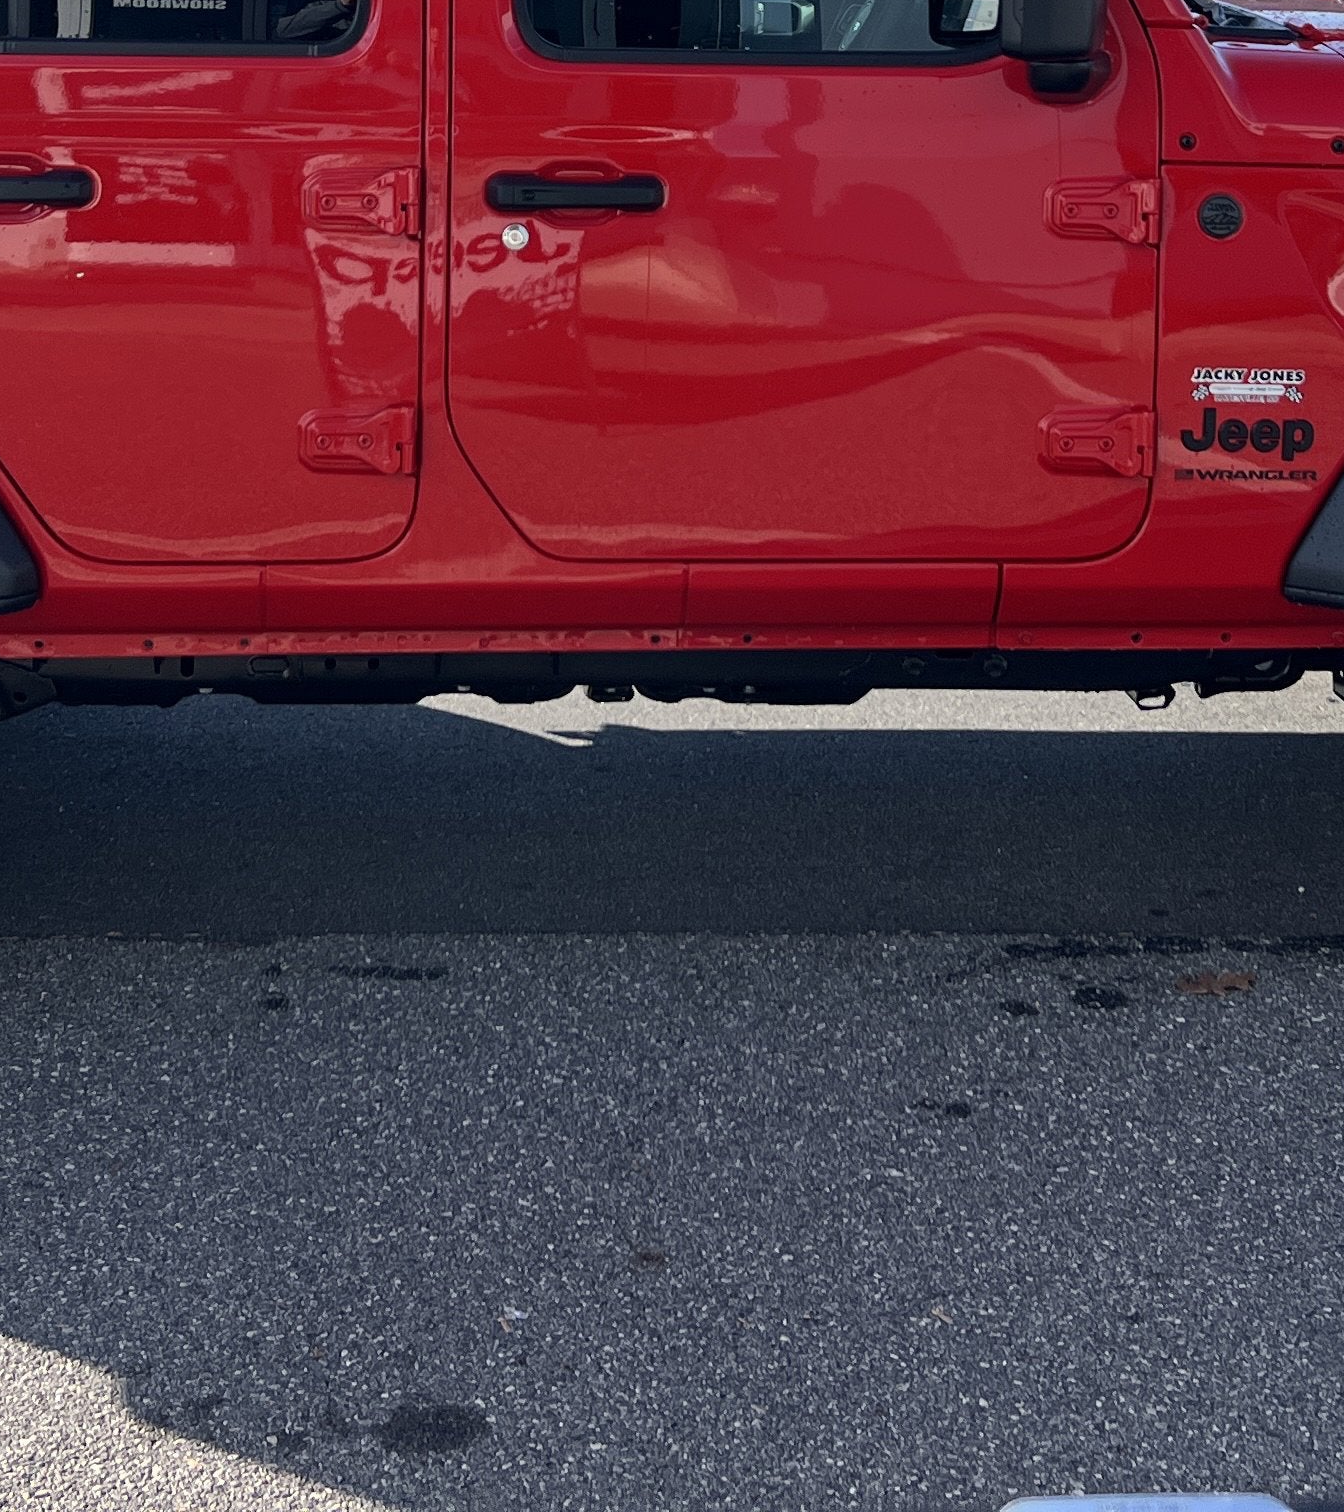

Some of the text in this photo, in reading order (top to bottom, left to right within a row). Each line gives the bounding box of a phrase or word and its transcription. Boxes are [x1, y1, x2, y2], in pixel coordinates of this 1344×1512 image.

[1194, 369, 1304, 382] JACKY JONES
[1180, 407, 1315, 462] Jeep
[1196, 469, 1318, 481] WRANGLER
